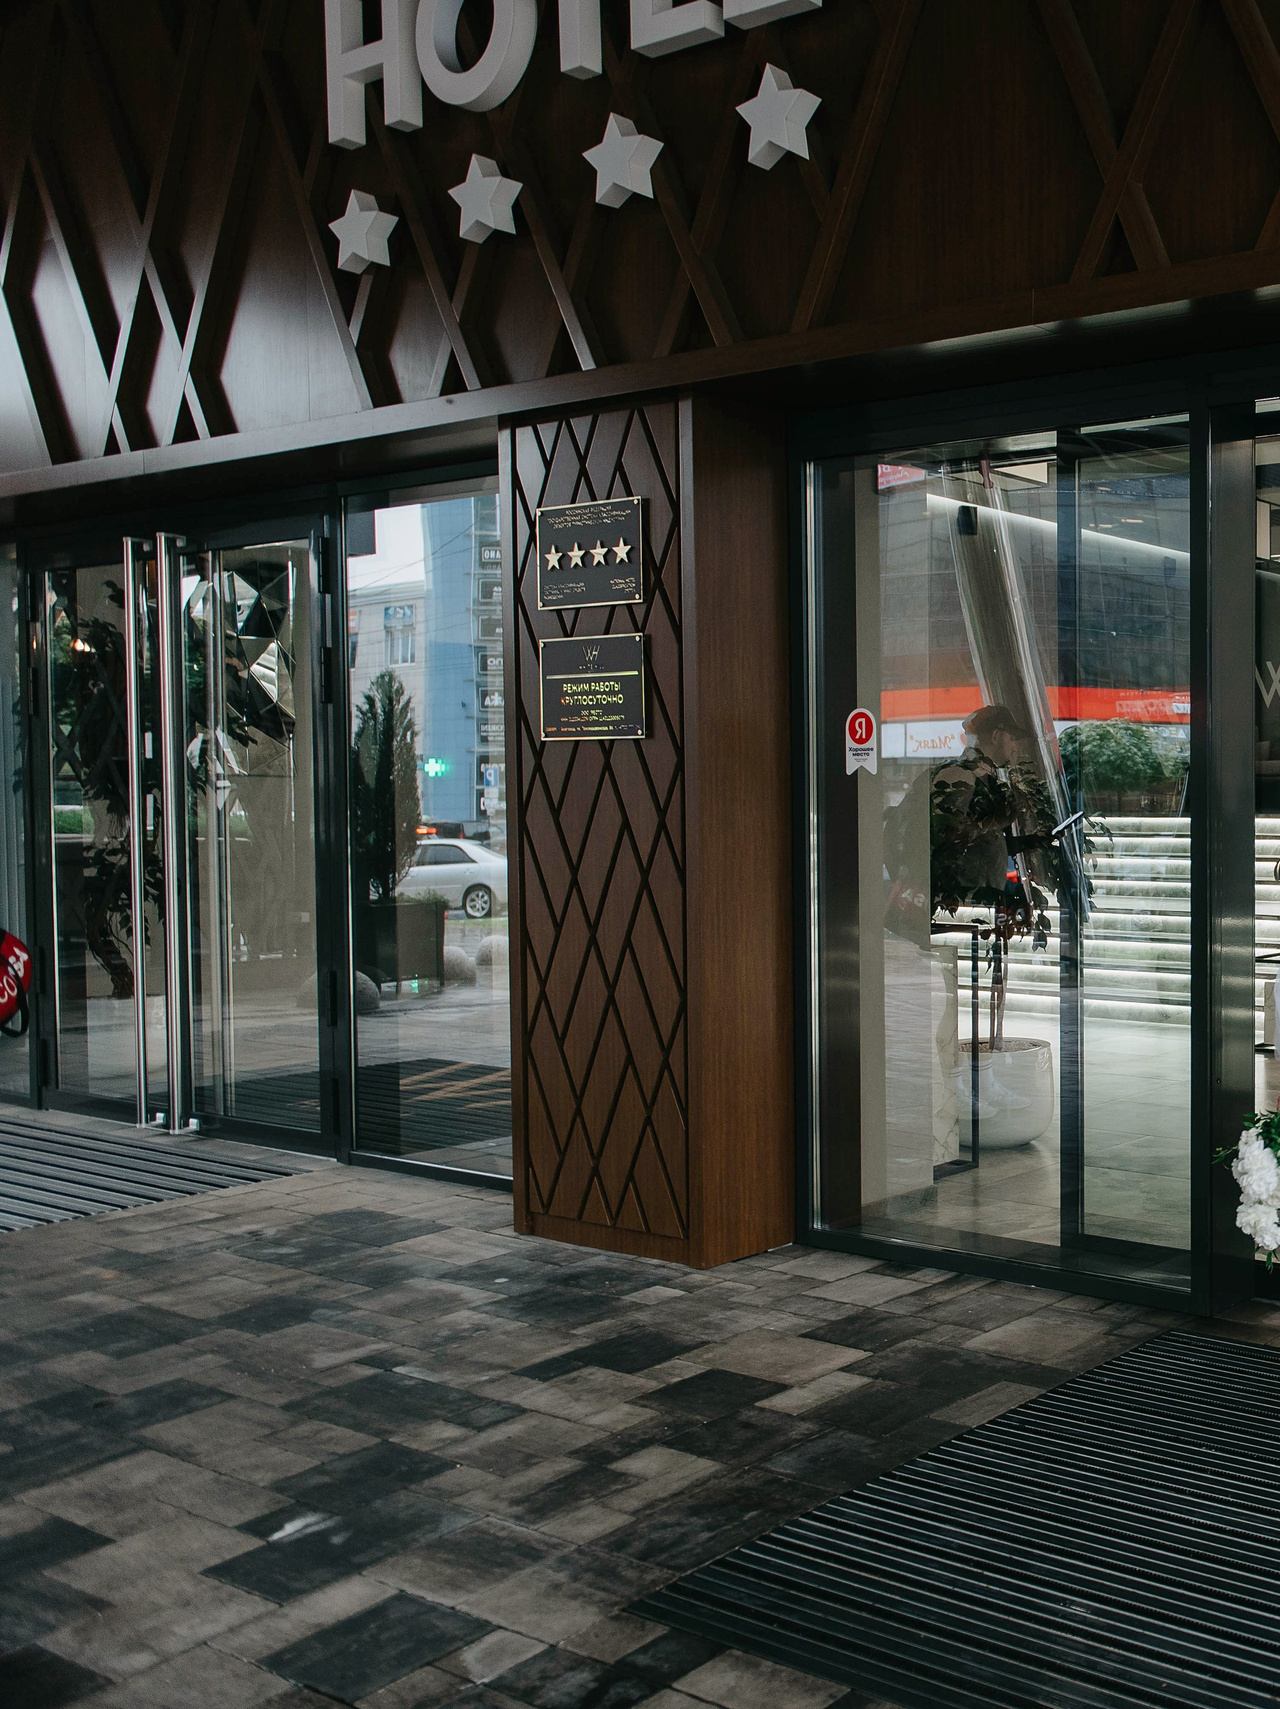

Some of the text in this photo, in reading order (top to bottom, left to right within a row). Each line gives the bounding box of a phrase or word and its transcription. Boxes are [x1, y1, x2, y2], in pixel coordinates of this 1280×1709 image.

[562, 681, 621, 694] РЕЖИМ РАБОТЫ
[560, 694, 624, 706] КРУГЛОСУТОЧНО
[855, 718, 866, 739] Я
[848, 746, 875, 754] Хорошее
